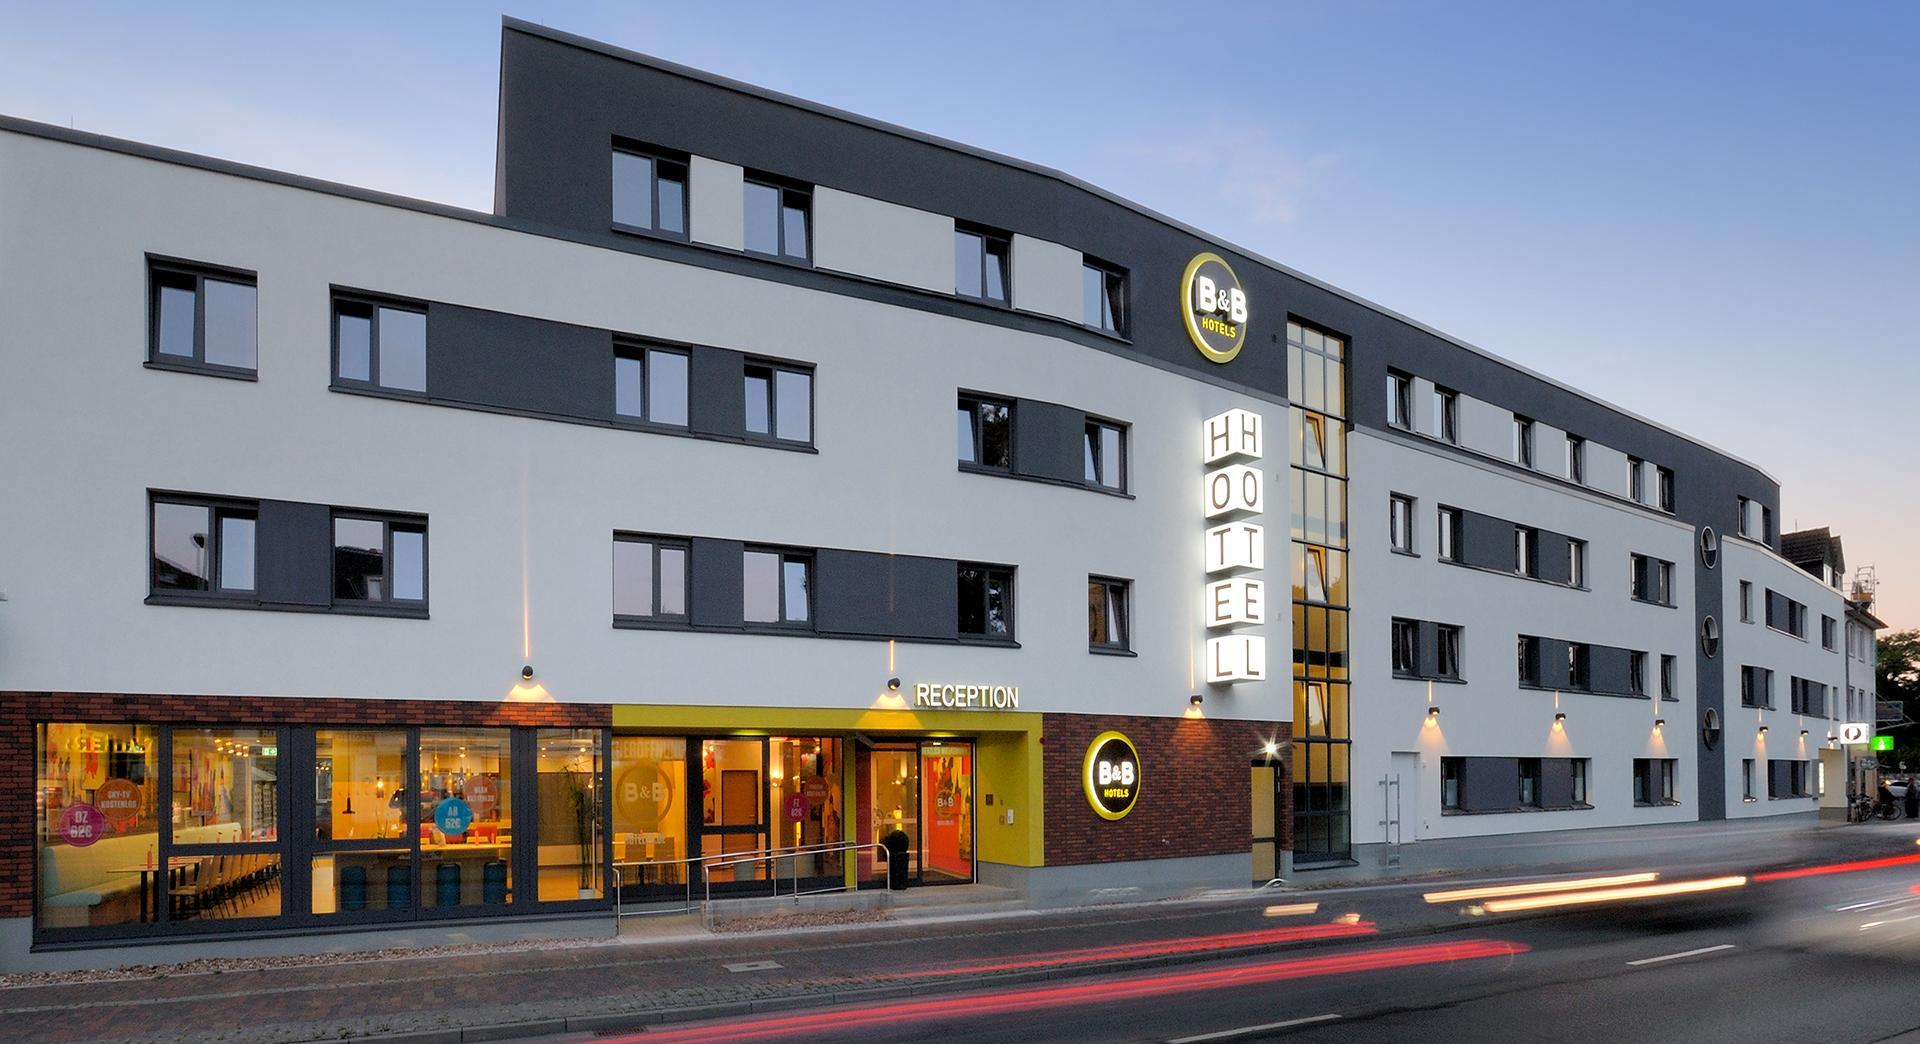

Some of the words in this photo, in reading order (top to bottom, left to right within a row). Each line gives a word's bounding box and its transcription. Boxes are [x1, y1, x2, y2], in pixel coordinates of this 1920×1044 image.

[1196, 275, 1248, 323] B&B
[1201, 316, 1237, 339] HOTELS
[1210, 415, 1233, 677] HOTEL
[1241, 413, 1260, 676] HOTEL
[915, 683, 1020, 708] RECEPTION
[1099, 761, 1135, 785] B&B
[624, 783, 665, 802] B&B
[1104, 788, 1129, 798] HOTELS
